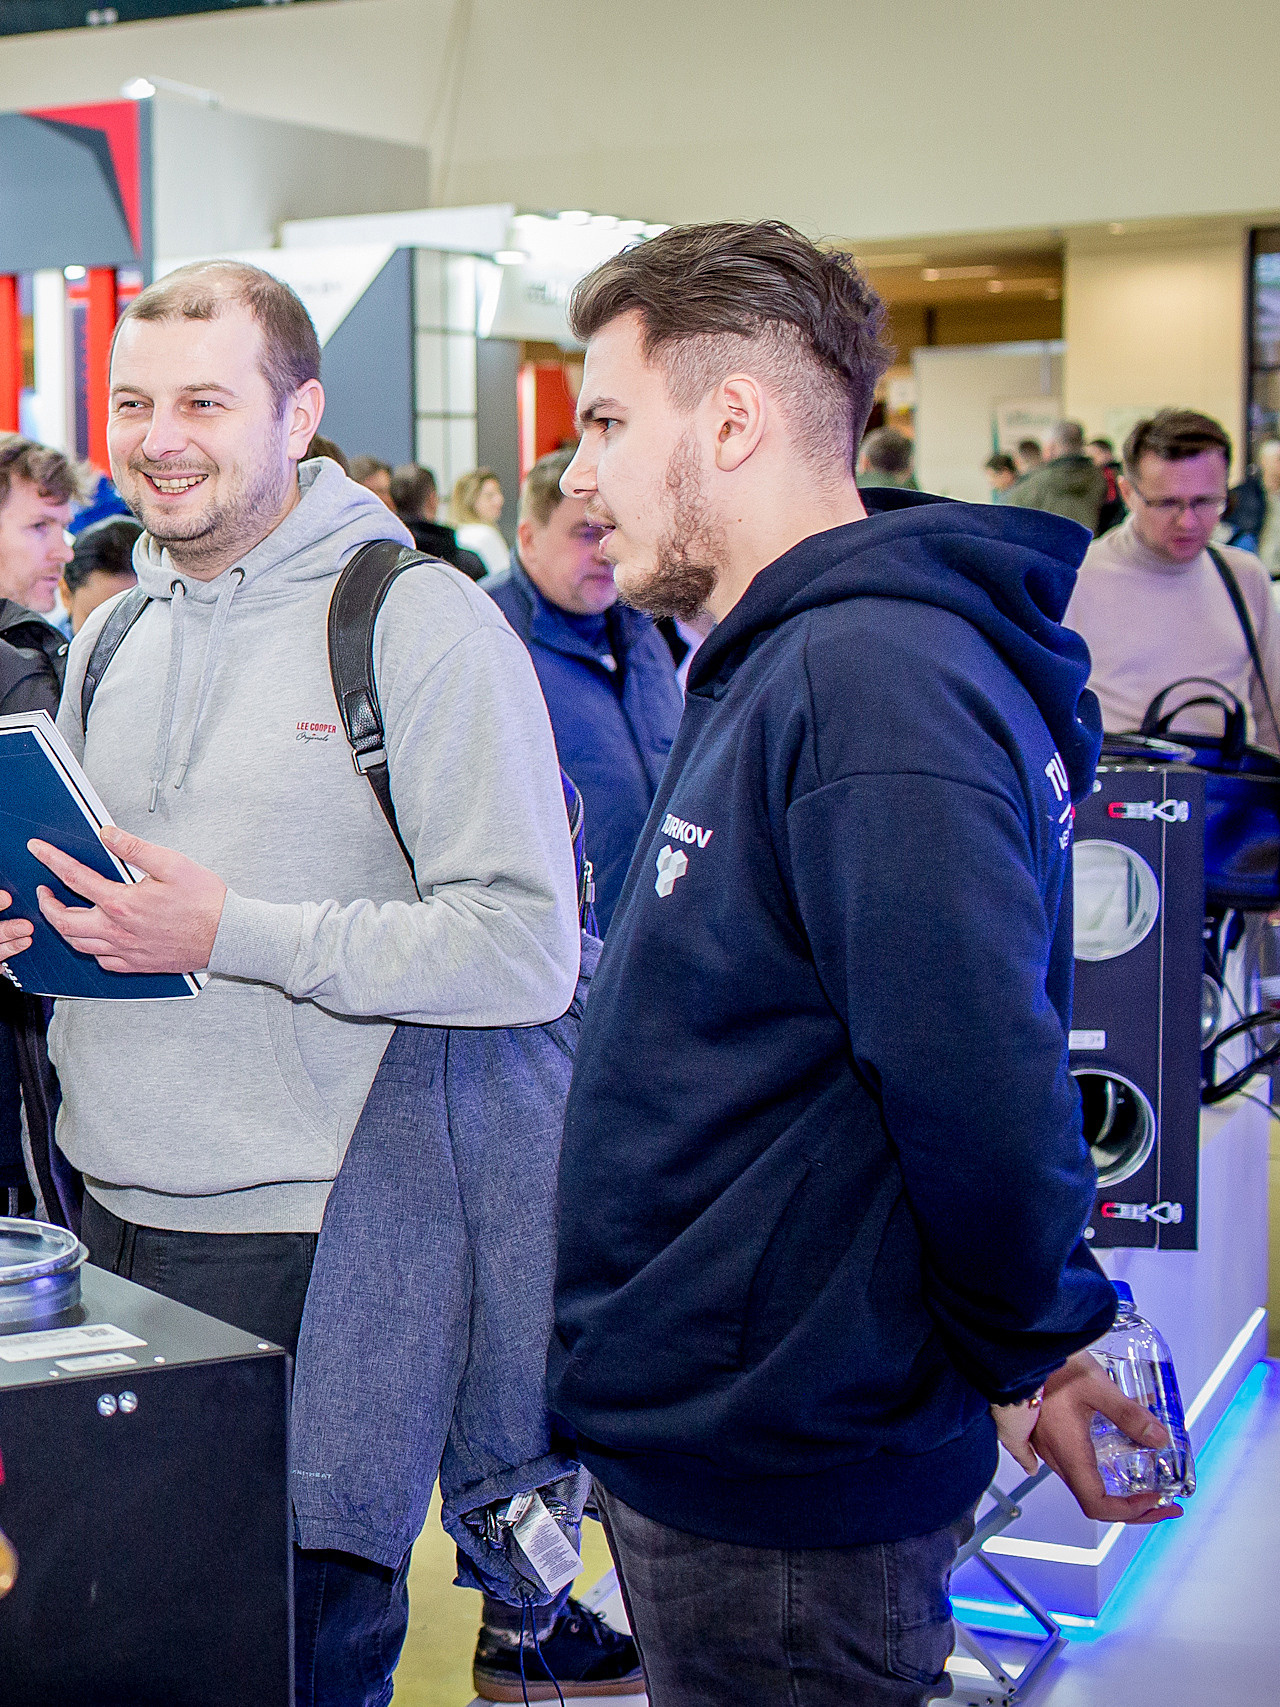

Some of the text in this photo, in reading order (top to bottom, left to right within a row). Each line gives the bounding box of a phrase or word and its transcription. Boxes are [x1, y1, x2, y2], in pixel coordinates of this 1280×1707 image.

[296, 722, 336, 733] LEE COOPER
[661, 813, 714, 849] TURKOV
